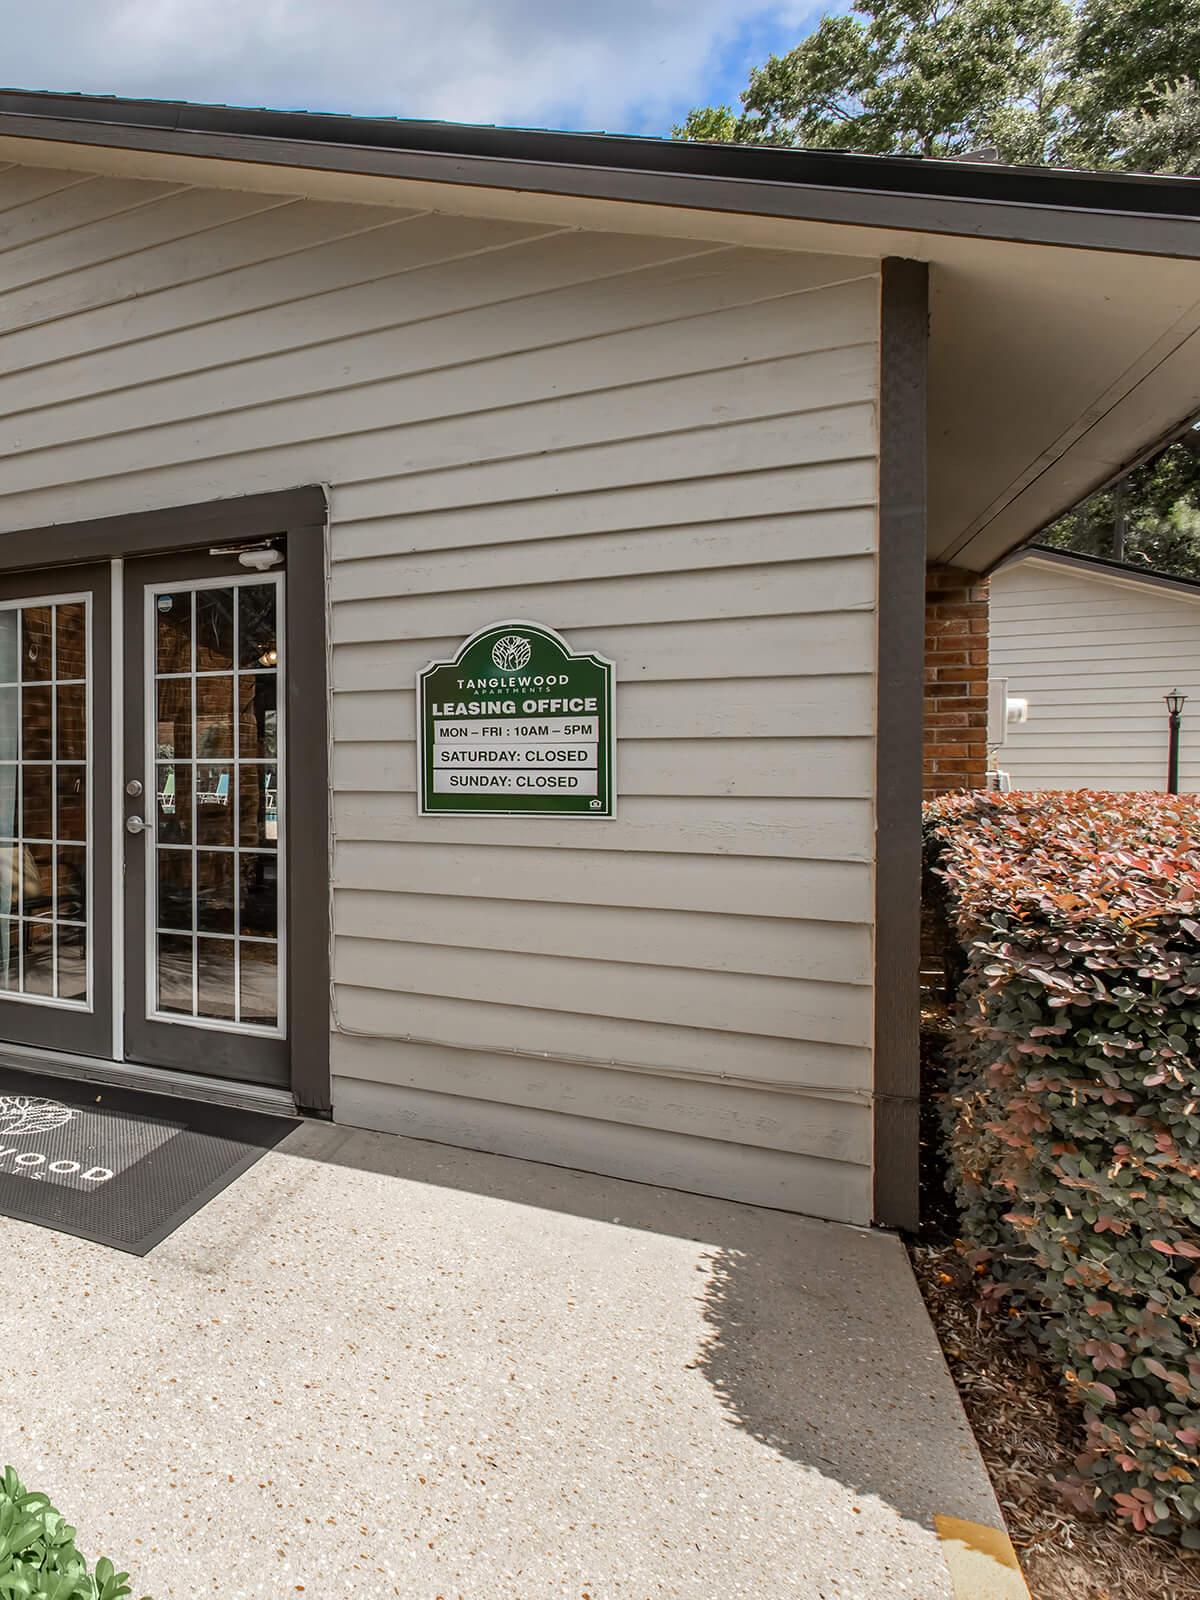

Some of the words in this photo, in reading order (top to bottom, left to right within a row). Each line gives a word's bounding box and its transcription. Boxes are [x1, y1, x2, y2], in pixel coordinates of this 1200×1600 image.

[457, 675, 569, 689] TANGLEWOOD
[474, 687, 551, 695] APARTMENTS
[432, 701, 516, 716] LEASING
[522, 698, 598, 713] OFFICE
[439, 727, 468, 737] MON
[514, 726, 549, 737] 10AM
[564, 725, 593, 735] 5PM
[441, 751, 521, 762] SATURDAY:
[525, 751, 588, 762] CLOSED
[450, 776, 512, 787] SUNDAY:
[516, 776, 578, 788] CLOSED
